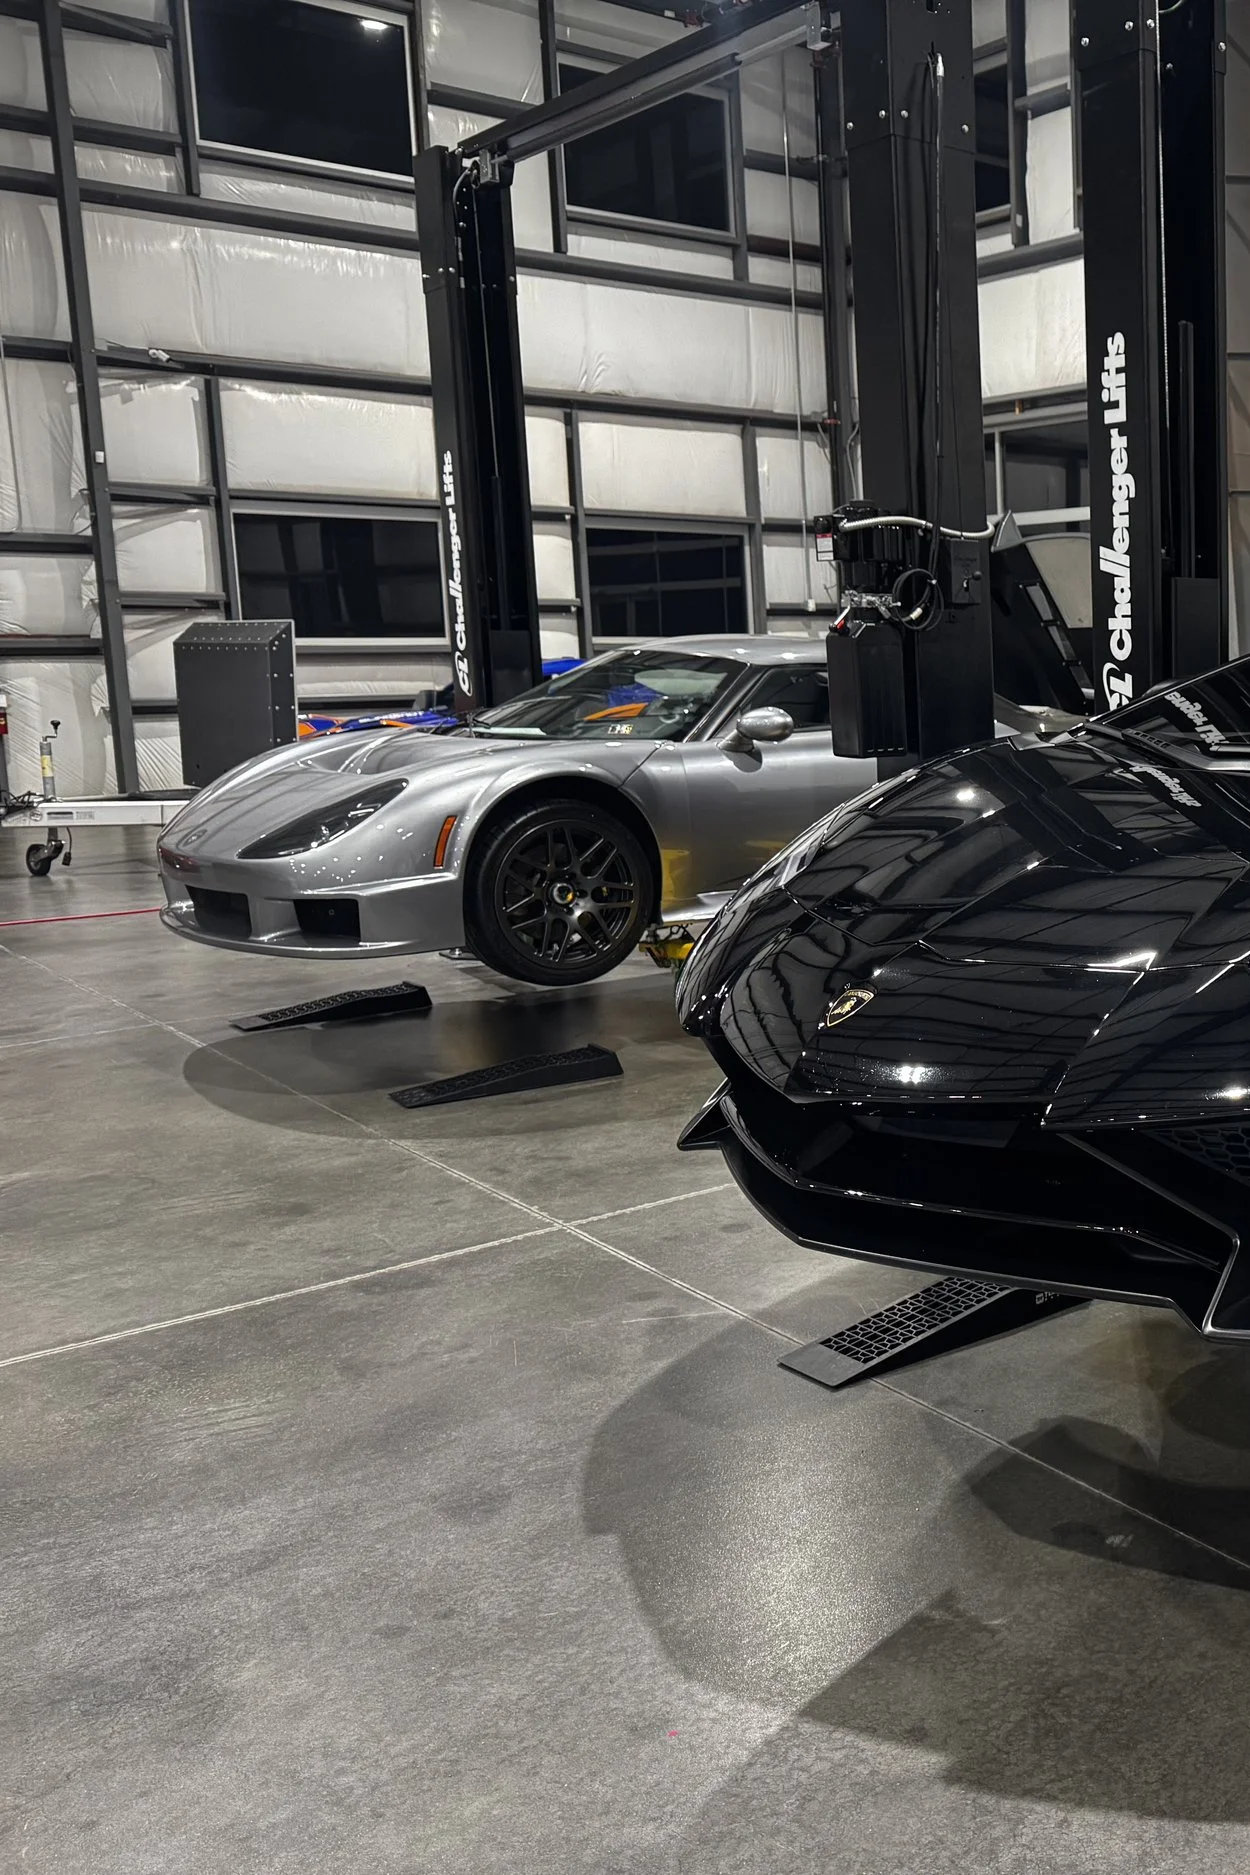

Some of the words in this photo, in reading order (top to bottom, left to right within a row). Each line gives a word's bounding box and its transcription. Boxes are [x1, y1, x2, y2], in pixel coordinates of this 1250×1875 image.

[1101, 331, 1127, 425] Lifts
[443, 450, 456, 506] Lifts
[448, 507, 466, 651] Challenger
[1099, 428, 1136, 661] Challenger
